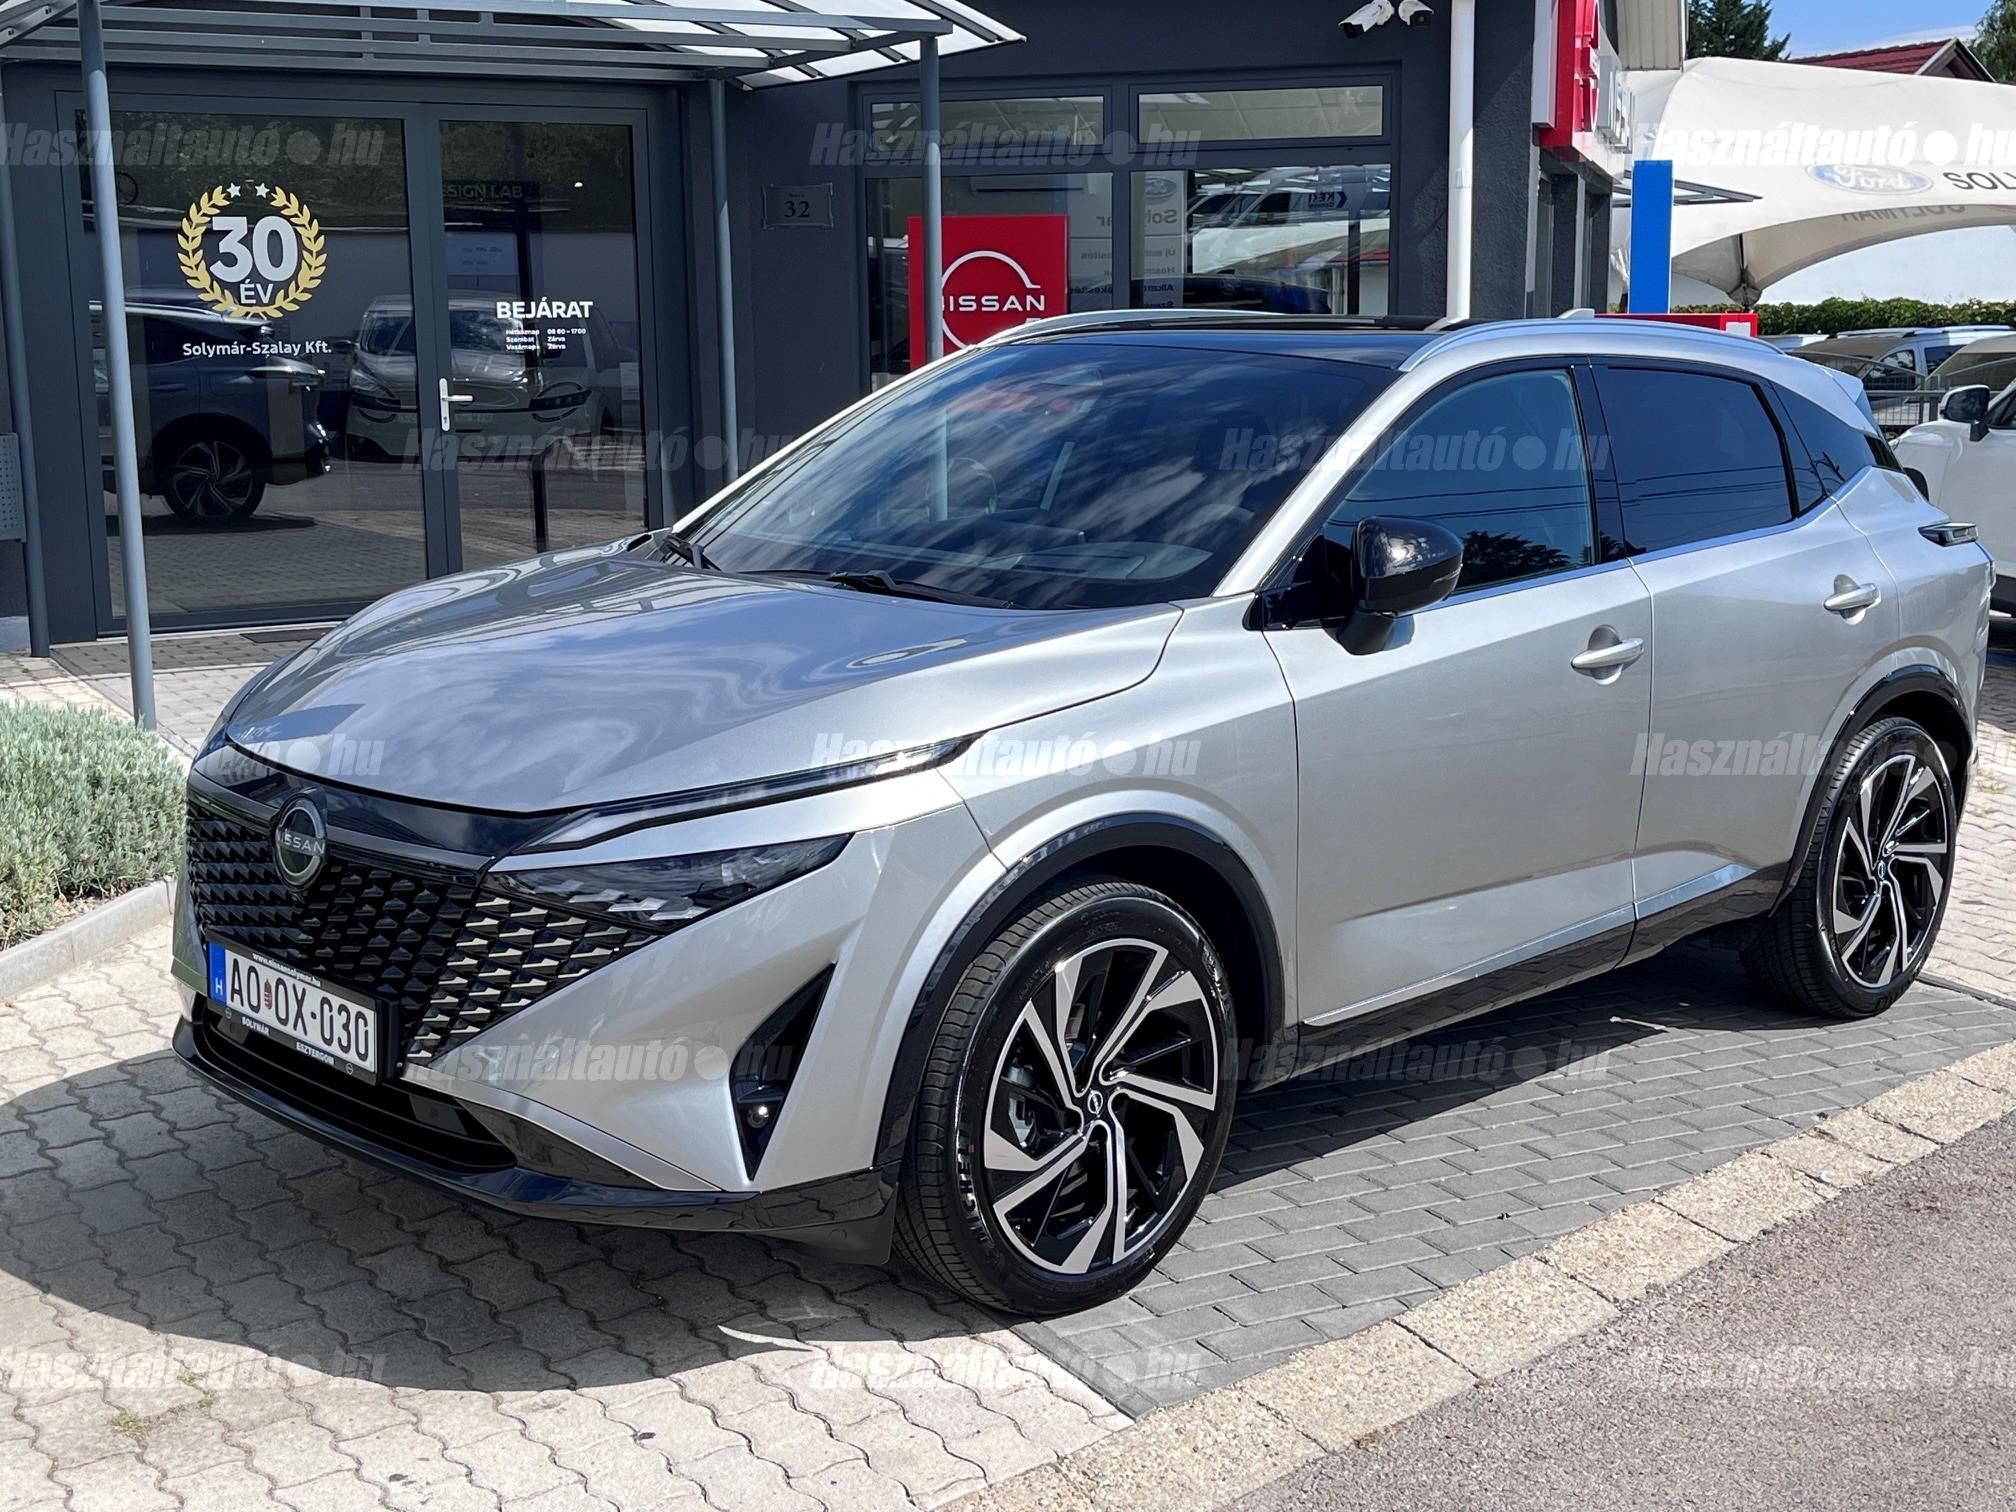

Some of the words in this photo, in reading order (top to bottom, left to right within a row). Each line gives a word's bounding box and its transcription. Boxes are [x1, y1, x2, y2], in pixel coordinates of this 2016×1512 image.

[1943, 172, 2016, 190] SOL
[784, 201, 810, 218] 32
[209, 215, 299, 283] 30
[239, 279, 274, 304] ÉV
[496, 297, 594, 319] BEJÁRAT
[941, 294, 1045, 312] ISSAN
[182, 341, 301, 358] Solymár-Szalay
[304, 340, 332, 354] Kft.
[215, 977, 224, 996] H
